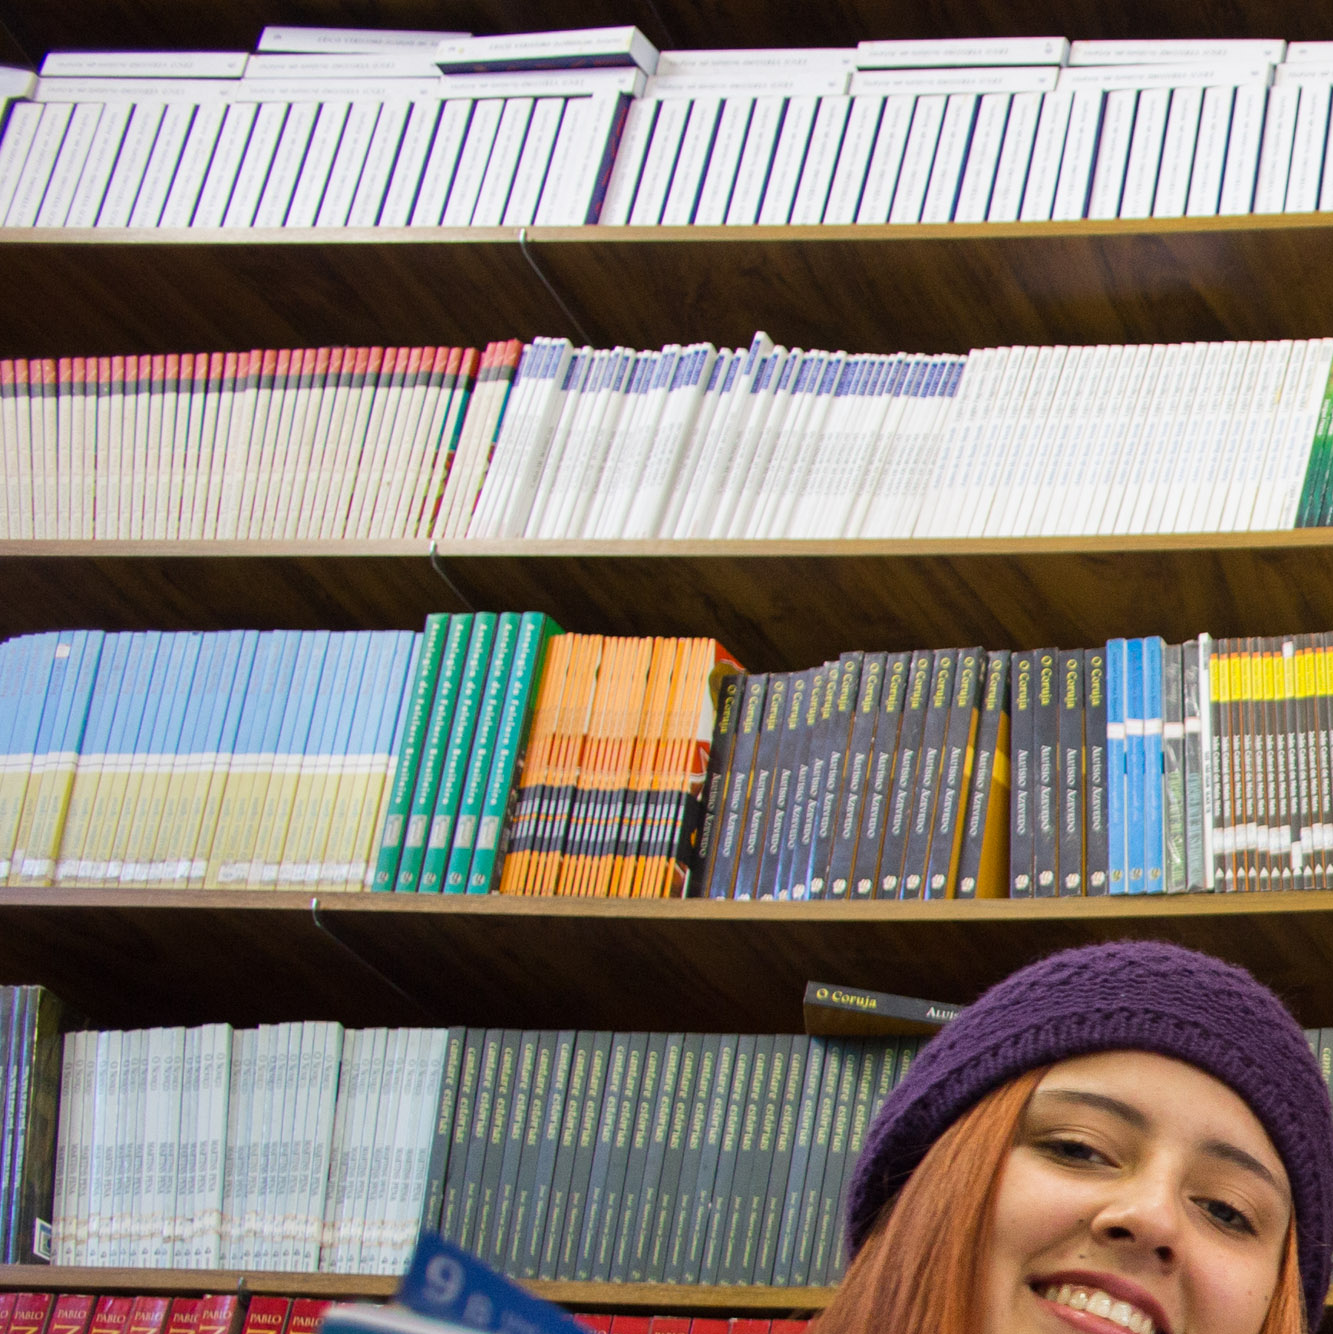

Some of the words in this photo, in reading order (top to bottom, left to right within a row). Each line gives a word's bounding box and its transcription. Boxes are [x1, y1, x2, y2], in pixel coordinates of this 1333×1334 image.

[1019, 660, 1029, 671] O
[1067, 659, 1077, 669] O
[1016, 673, 1029, 710] Coruja
[1064, 671, 1078, 709] Coruja
[816, 988, 828, 999] O
[832, 991, 877, 1009] Coruja
[422, 1256, 465, 1304] 9
[14, 1311, 44, 1320] PABLO
[58, 1309, 86, 1319] PABLO
[96, 1313, 125, 1323] PABLO
[134, 1311, 163, 1321] PABLO
[203, 1310, 232, 1320] PABLO
[250, 1315, 281, 1324] PABLO
